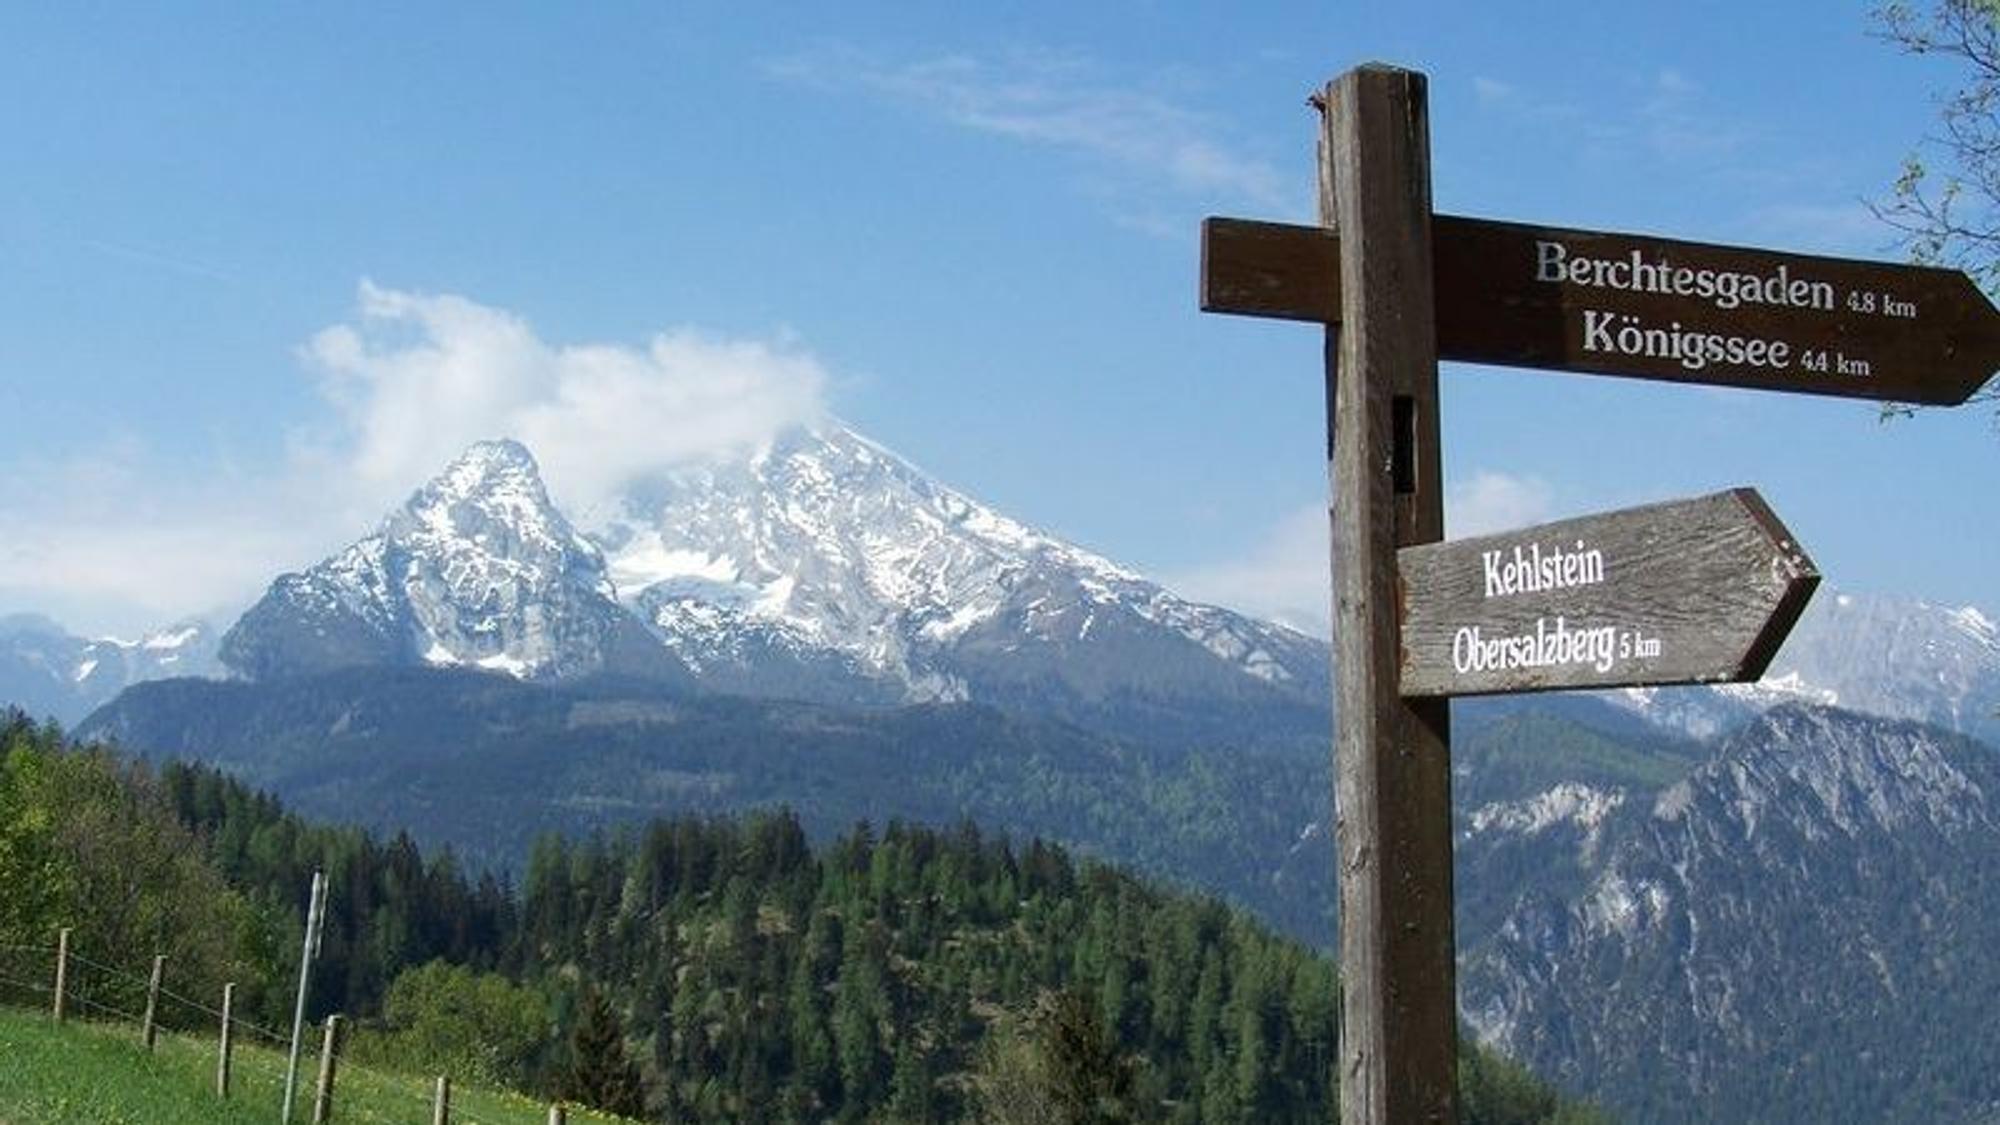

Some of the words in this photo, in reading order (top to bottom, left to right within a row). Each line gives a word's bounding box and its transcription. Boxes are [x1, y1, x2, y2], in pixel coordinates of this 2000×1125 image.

[1536, 240, 1834, 309] Berchtesgaden
[1883, 294, 1917, 318] km
[1583, 310, 1790, 369] Königssee
[1837, 353, 1870, 377] km
[1482, 540, 1604, 597] Kehlstein
[1453, 616, 1616, 673] Obersalzberg
[1619, 632, 1631, 660] 5
[1634, 633, 1661, 659] km
